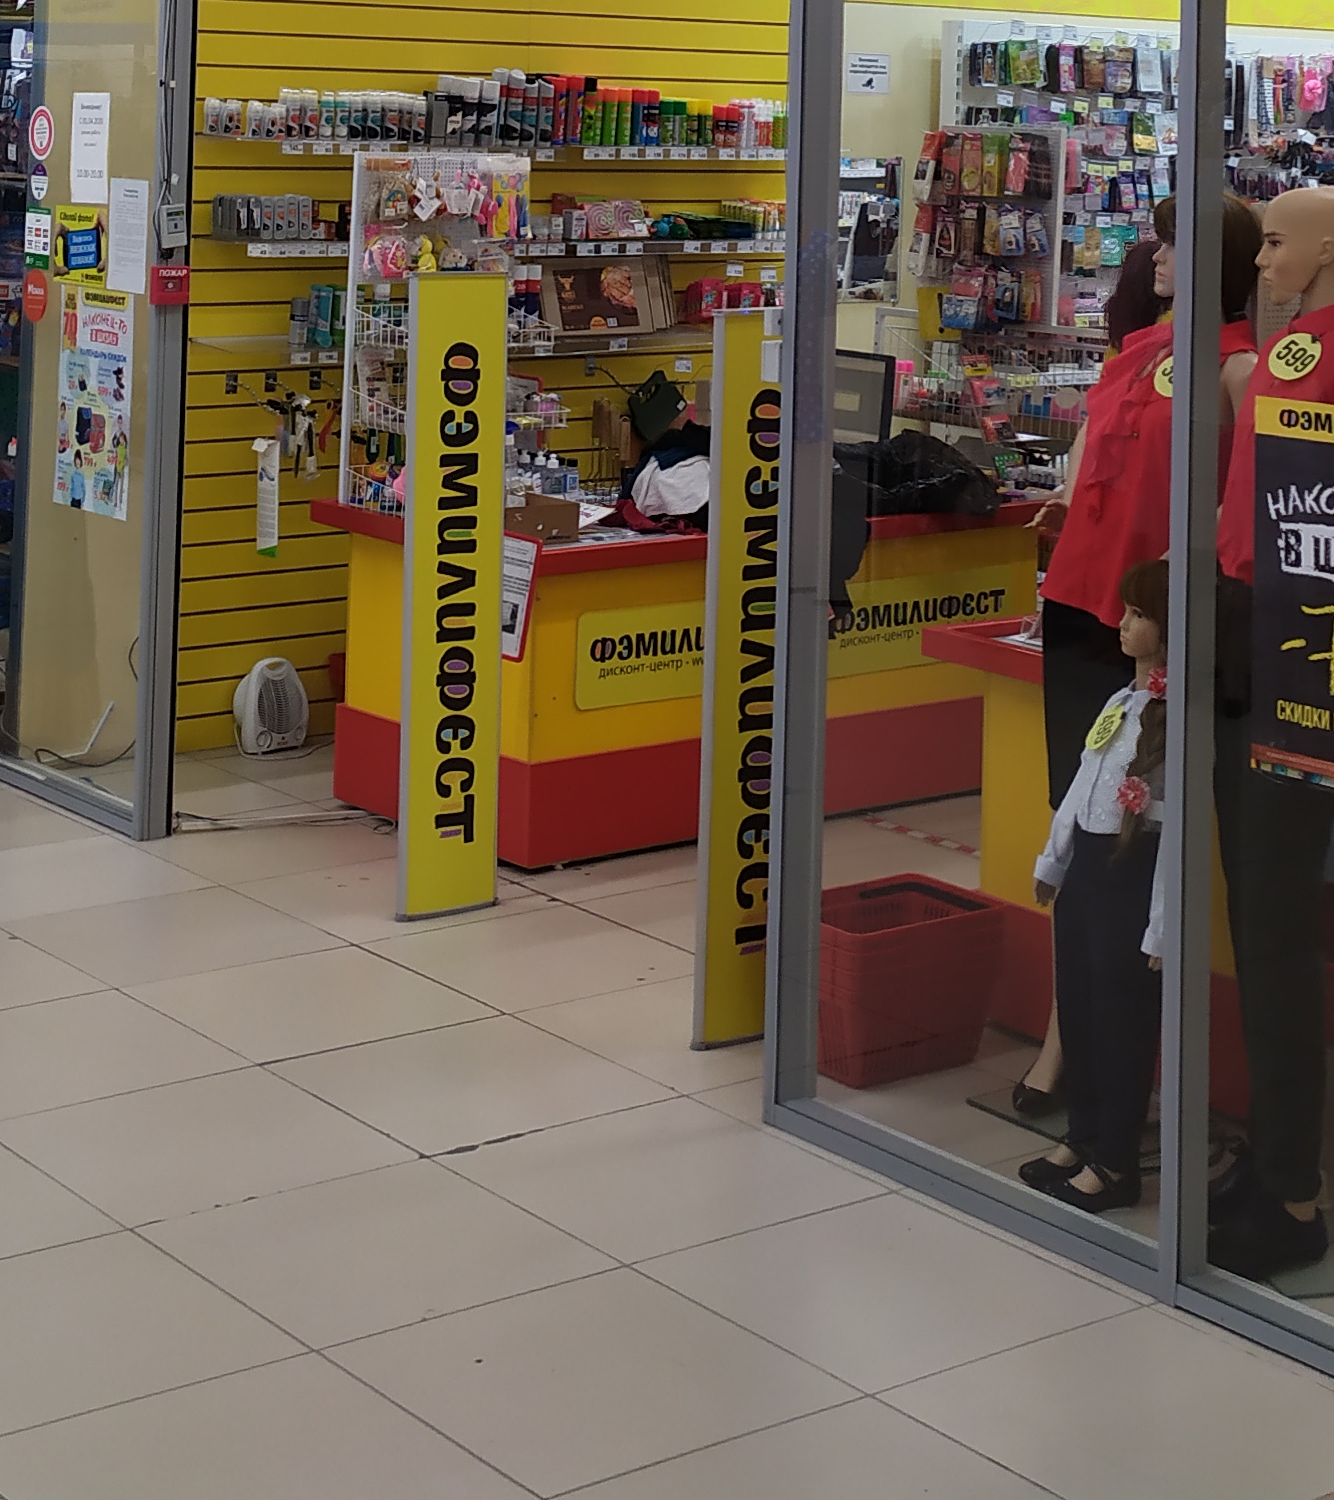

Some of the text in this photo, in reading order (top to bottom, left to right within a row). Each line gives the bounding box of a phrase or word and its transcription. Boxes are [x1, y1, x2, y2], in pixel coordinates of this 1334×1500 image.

[159, 269, 187, 278] ПОЖАР
[1275, 339, 1316, 373] 599
[1281, 527, 1302, 569] В
[434, 341, 481, 843] ФЭМИЛИФЕСТ
[840, 630, 914, 649] дисконт-центр
[598, 658, 682, 680] дисконт-центр
[1276, 699, 1330, 730] СКИДКИ
